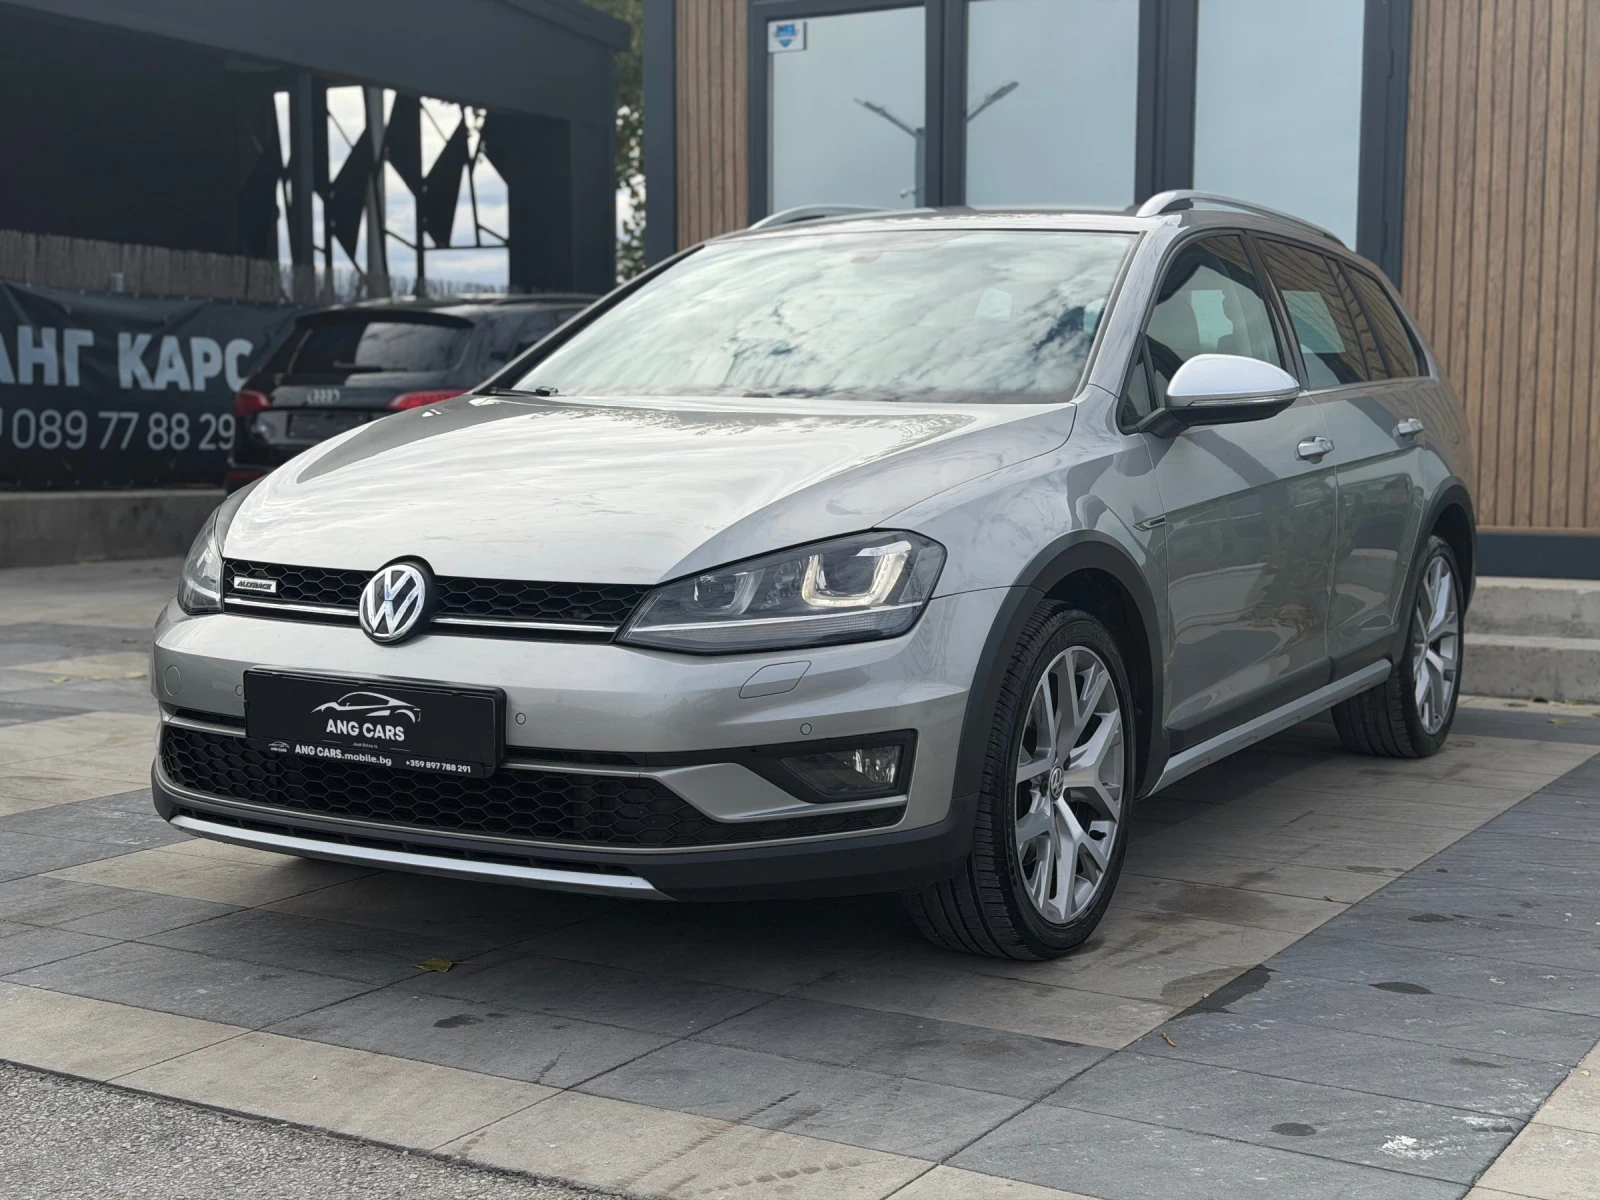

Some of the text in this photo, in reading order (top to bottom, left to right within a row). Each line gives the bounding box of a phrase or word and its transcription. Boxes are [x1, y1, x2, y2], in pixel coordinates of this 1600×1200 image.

[118, 332, 254, 391] КАРС
[12, 408, 88, 449] 089
[98, 411, 139, 449] 77
[147, 412, 190, 450] 88
[326, 719, 405, 741] ANG CARS
[294, 744, 392, 767] ANG CARS.mobile.bg
[405, 760, 472, 774] +359 897 788 291
